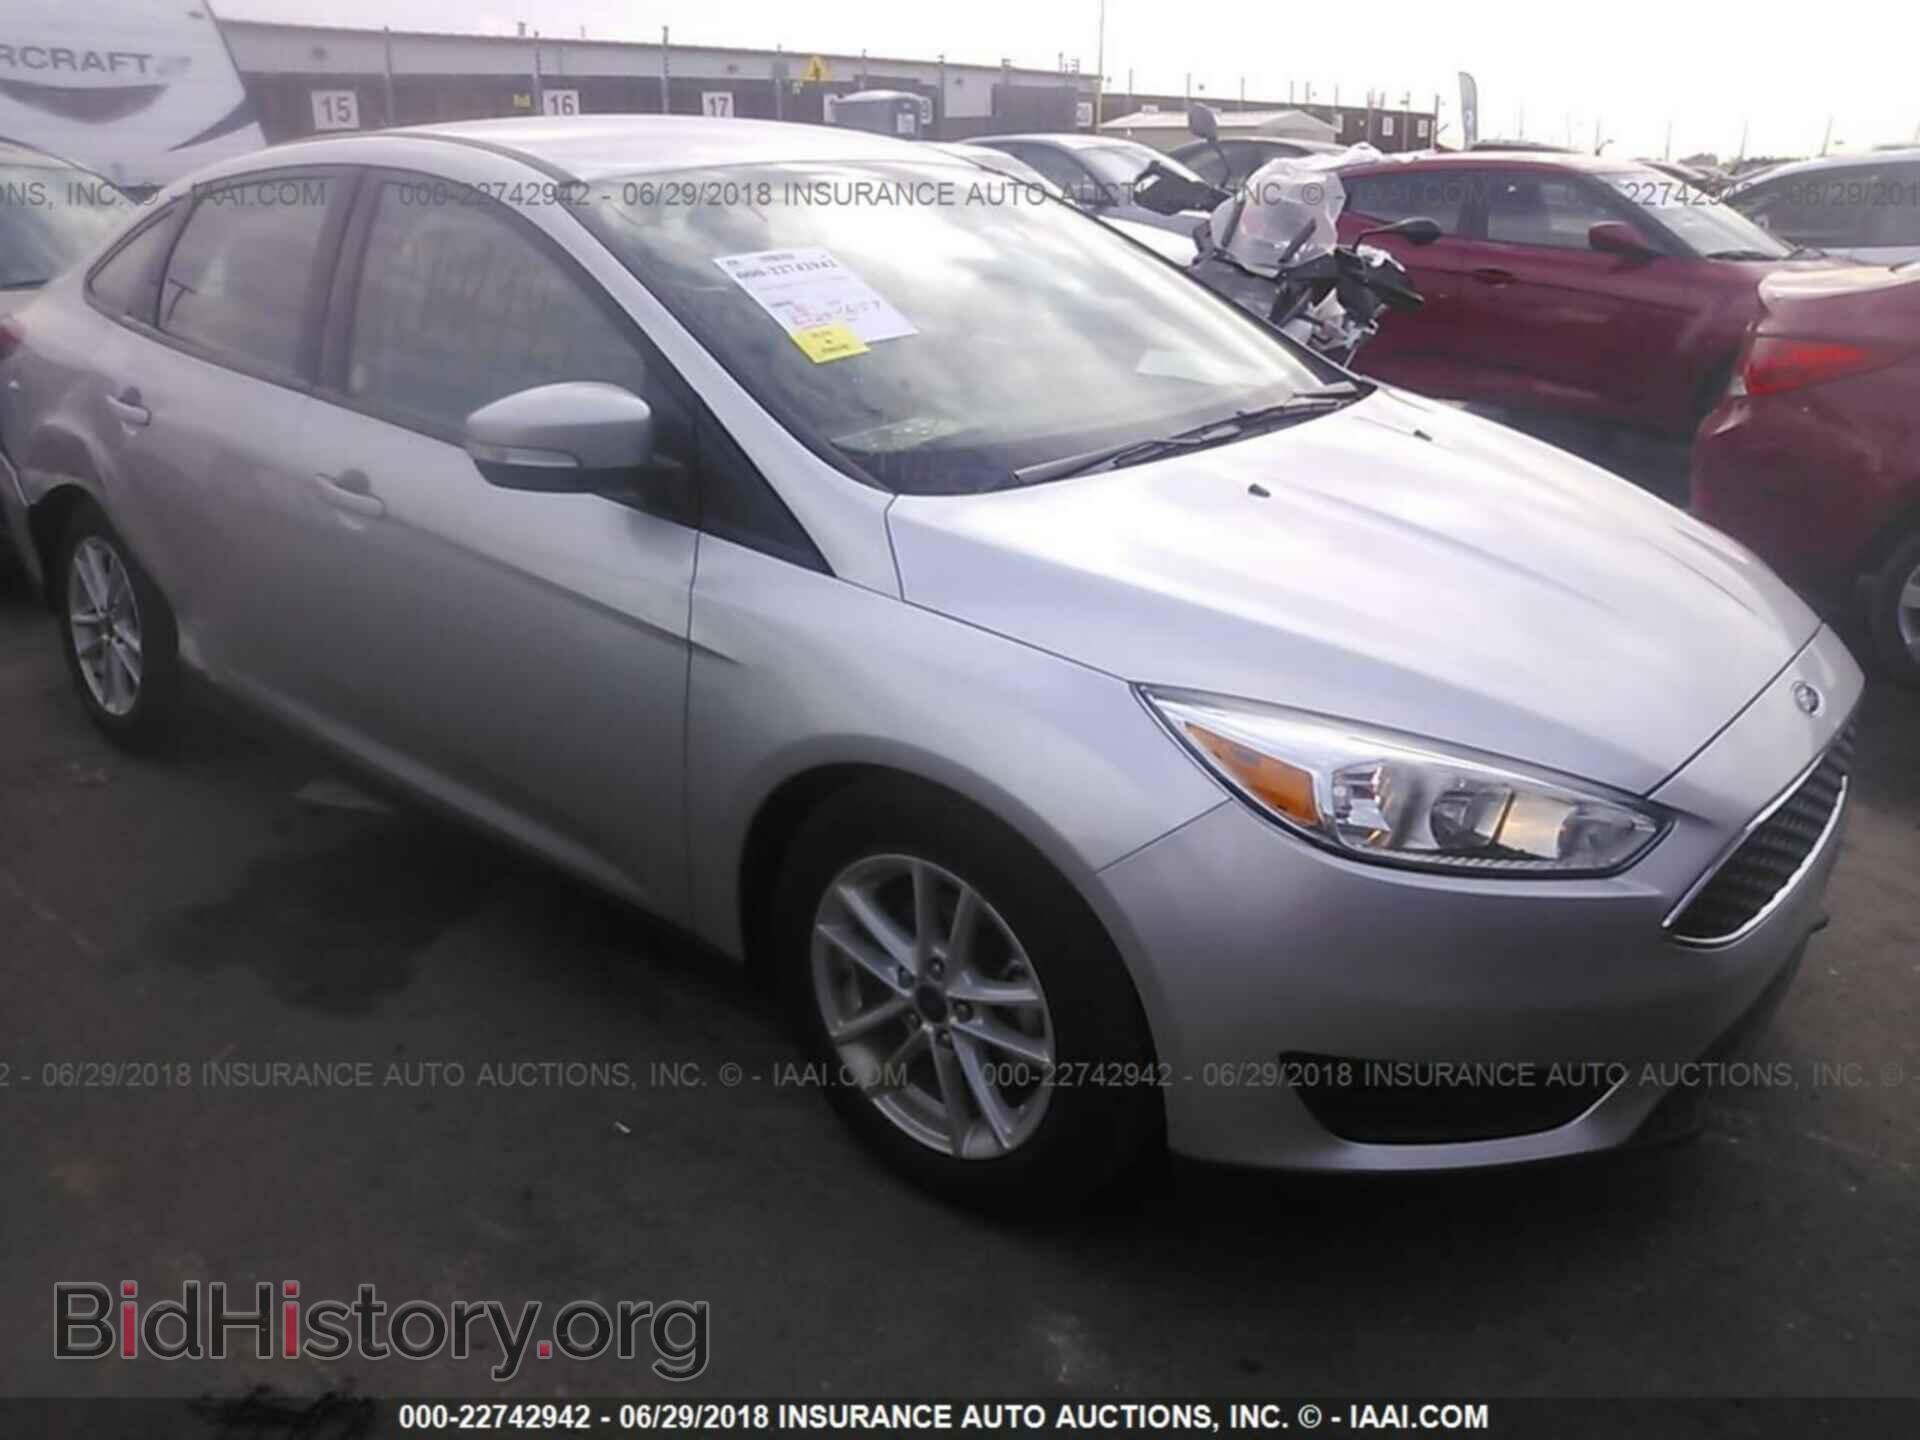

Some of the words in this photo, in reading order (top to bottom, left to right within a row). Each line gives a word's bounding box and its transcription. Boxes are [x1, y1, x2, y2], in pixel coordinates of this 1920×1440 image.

[321, 96, 351, 122] 15
[551, 96, 574, 116] 16
[709, 97, 729, 118] 17
